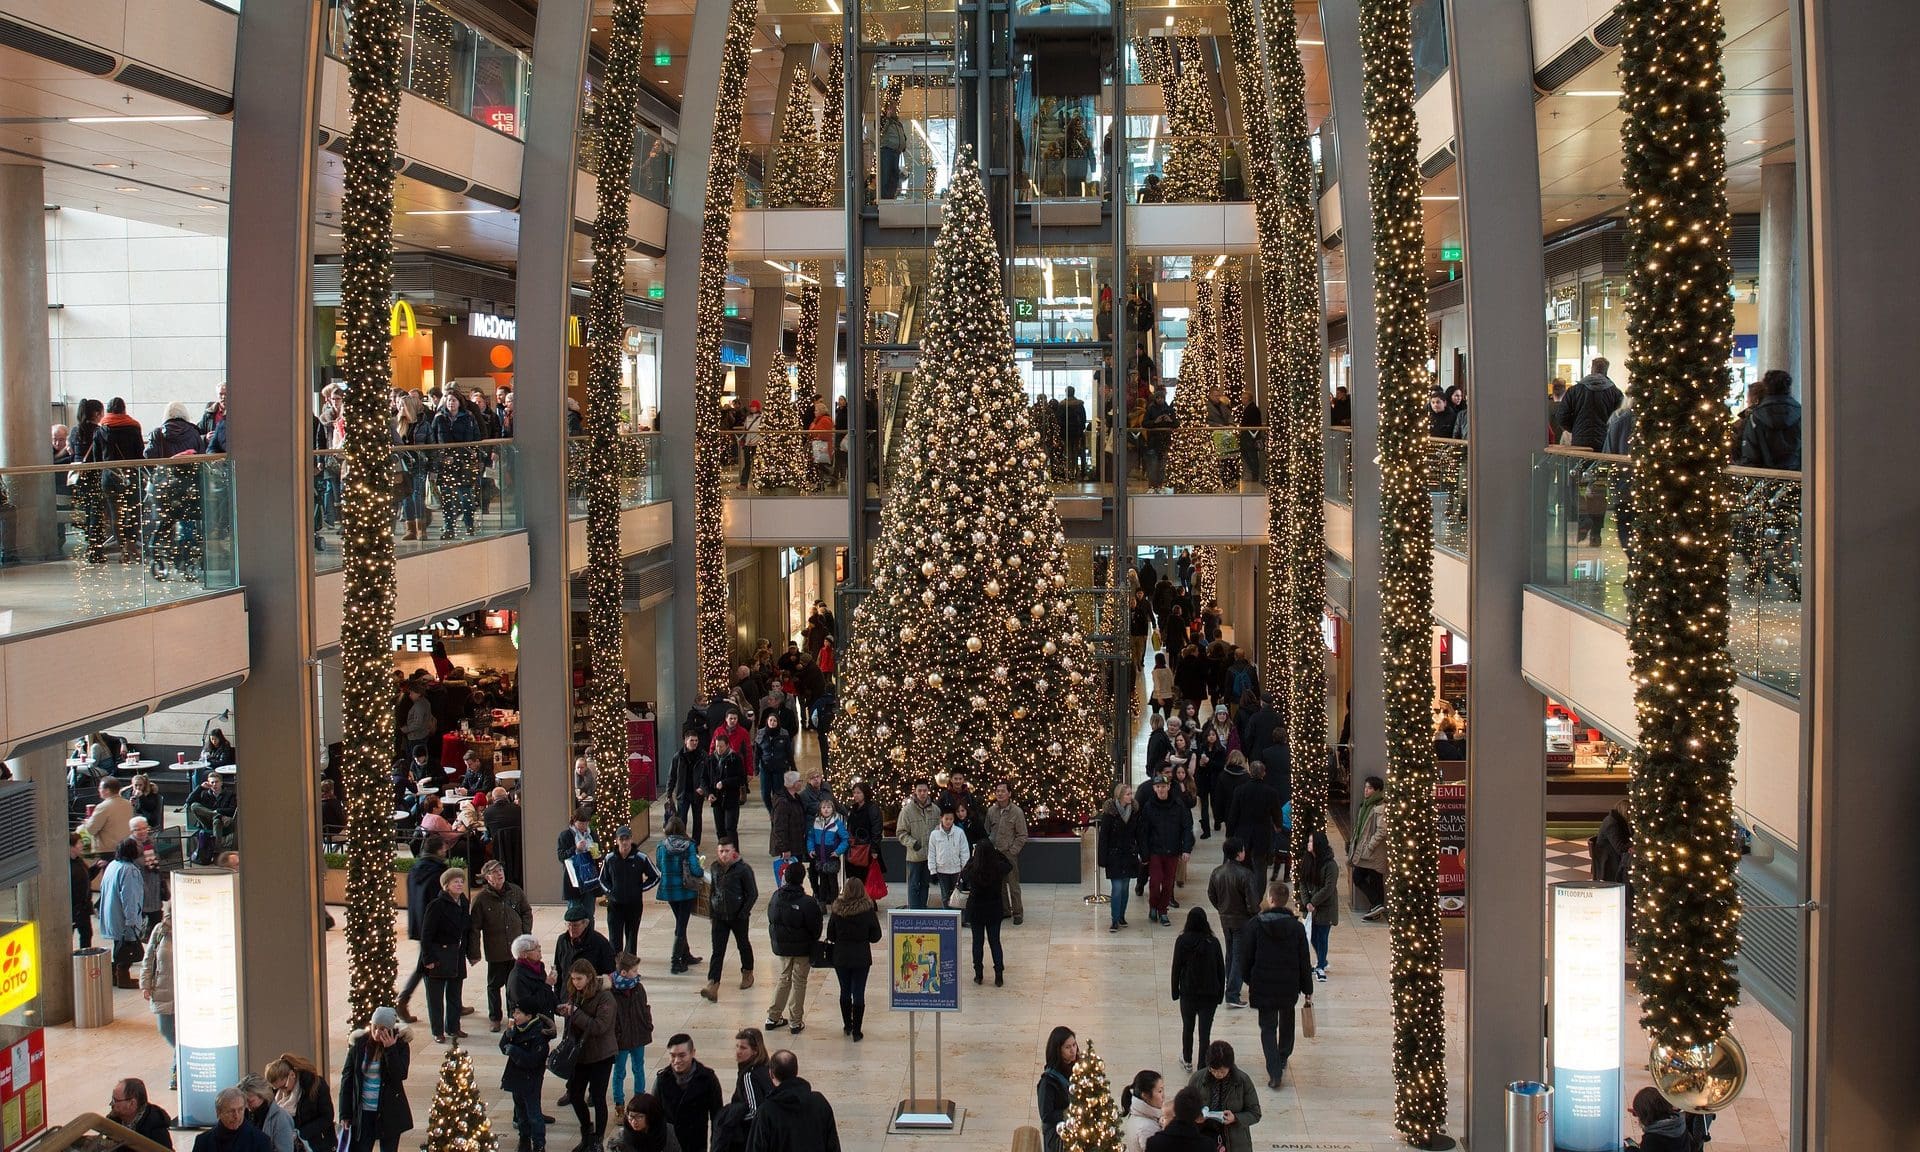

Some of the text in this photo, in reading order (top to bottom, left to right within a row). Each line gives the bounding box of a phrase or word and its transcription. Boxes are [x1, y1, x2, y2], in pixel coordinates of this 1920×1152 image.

[492, 110, 513, 121] cha
[1019, 304, 1032, 316] E2
[391, 634, 433, 652] FEE
[894, 919, 955, 927] AHOI HAMBURG
[0, 970, 28, 996] OTTO
